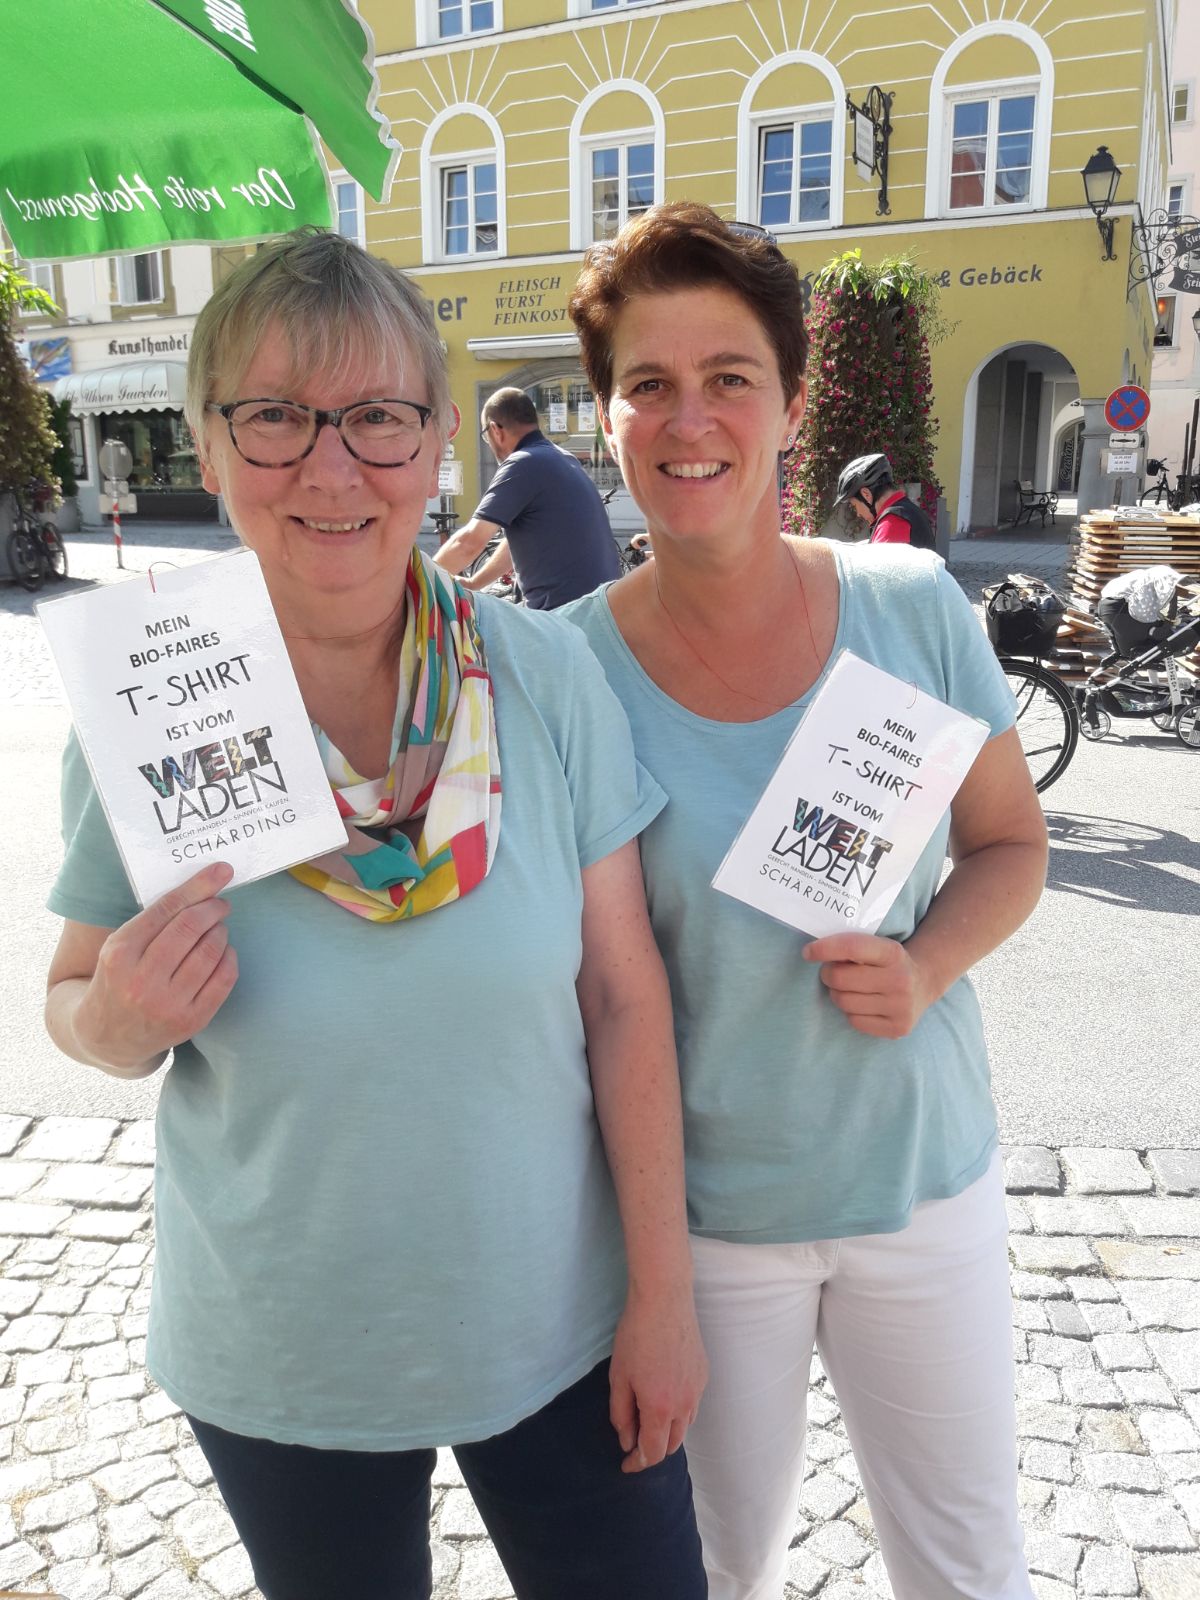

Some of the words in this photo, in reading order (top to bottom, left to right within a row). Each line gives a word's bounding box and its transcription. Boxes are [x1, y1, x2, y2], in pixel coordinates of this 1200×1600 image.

[498, 276, 561, 294] FLEISCH
[959, 264, 1043, 287] Gebäck
[494, 308, 568, 326] FEINKOST
[495, 294, 546, 309] WURST
[108, 333, 188, 356] Kunsthandel
[144, 614, 191, 638] MEIN
[129, 631, 221, 669] BIO-FAIRES
[166, 719, 194, 741] IST
[194, 709, 235, 733] VOM
[883, 718, 917, 743] MEIN
[137, 725, 274, 799] WELT
[857, 727, 922, 769] BIO-FAIRES
[152, 761, 288, 835] LADEN
[832, 790, 853, 808] IST
[854, 801, 884, 824] VOM
[171, 808, 296, 863] SCHÄRDING
[792, 797, 894, 869] WELT
[771, 825, 877, 897] LADEN
[759, 863, 856, 918] SCHÄRDING
